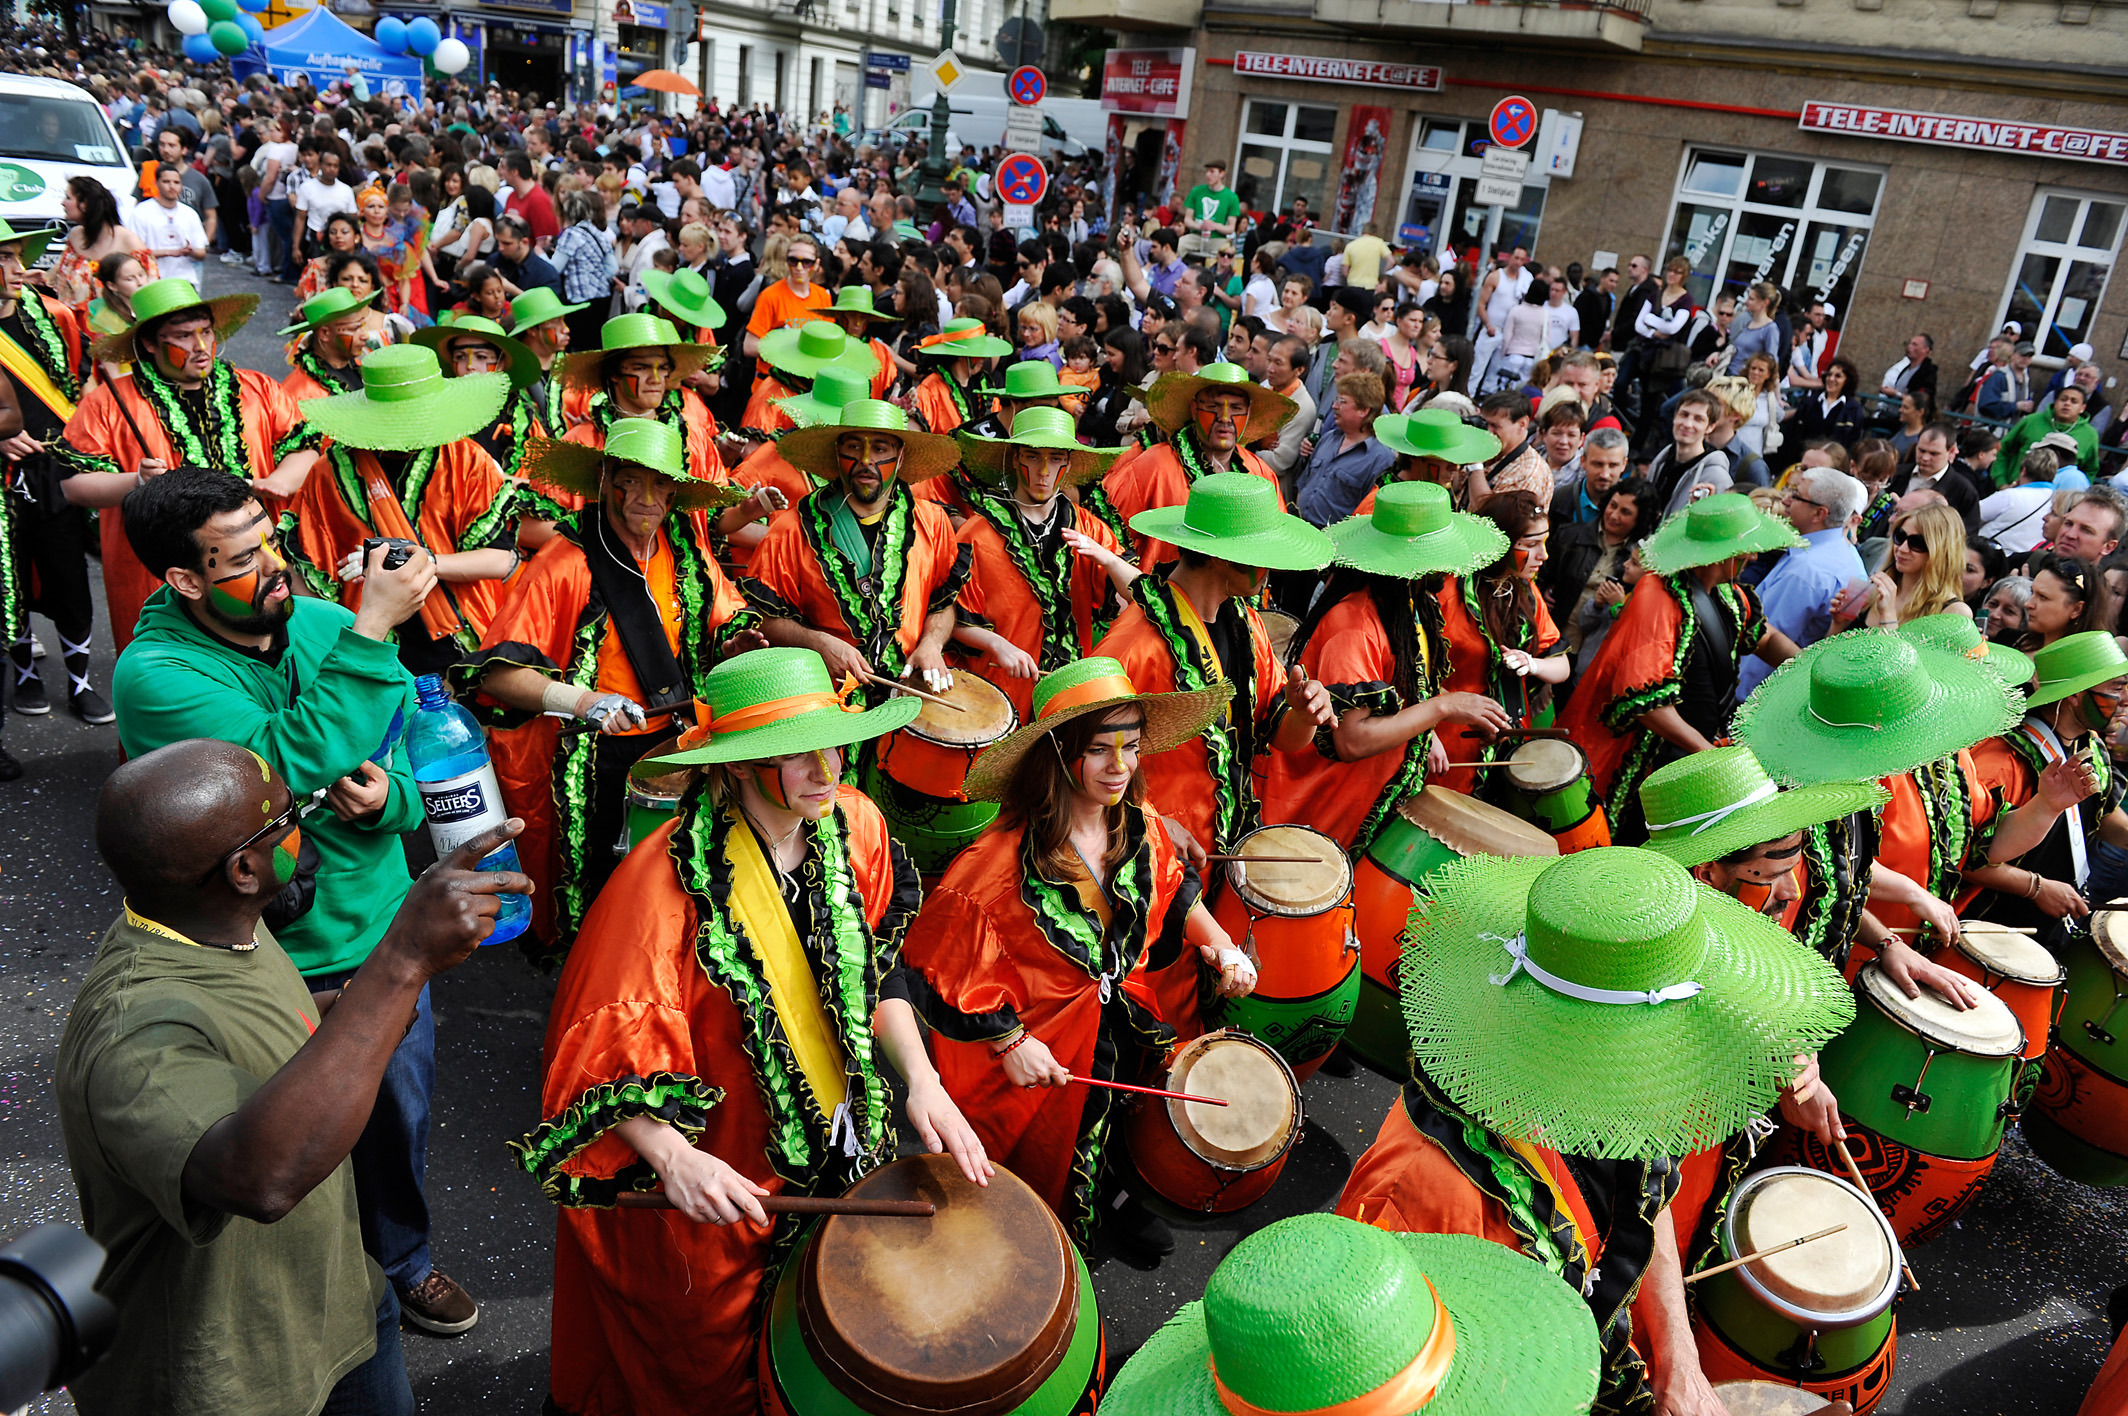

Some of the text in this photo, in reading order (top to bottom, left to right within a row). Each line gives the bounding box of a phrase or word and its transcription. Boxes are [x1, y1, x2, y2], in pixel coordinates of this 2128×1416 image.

[1132, 60, 1151, 75] TELE
[1244, 54, 1429, 85] TELE-INTERNET-C@FE
[1815, 106, 2128, 159] TELE-INTERNET-C@FE
[12, 183, 44, 193] Club
[425, 788, 481, 815] SELTERS
